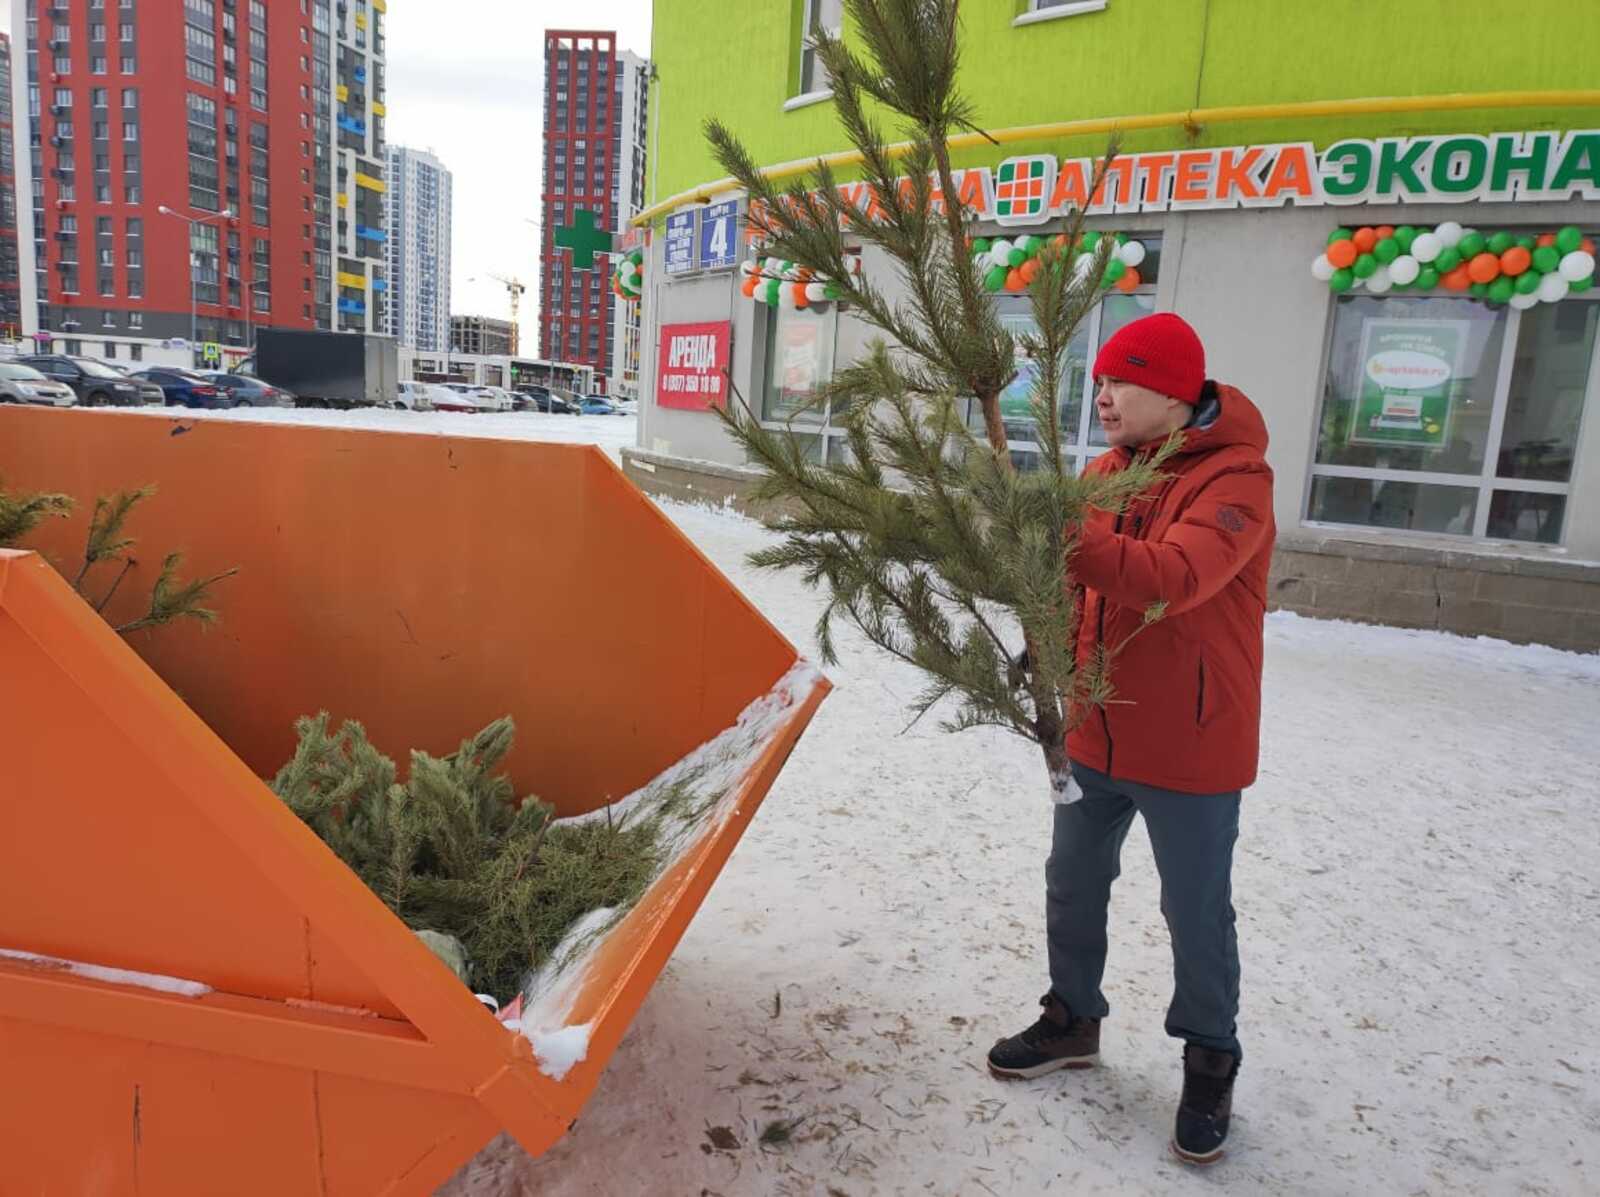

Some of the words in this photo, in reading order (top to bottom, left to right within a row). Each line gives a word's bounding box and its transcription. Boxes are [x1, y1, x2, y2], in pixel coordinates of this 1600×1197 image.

[1049, 146, 1312, 208] АПТЕКА
[1323, 133, 1600, 196] ЭКОНА
[710, 216, 727, 258] 4
[669, 334, 716, 374] АРЕНДА
